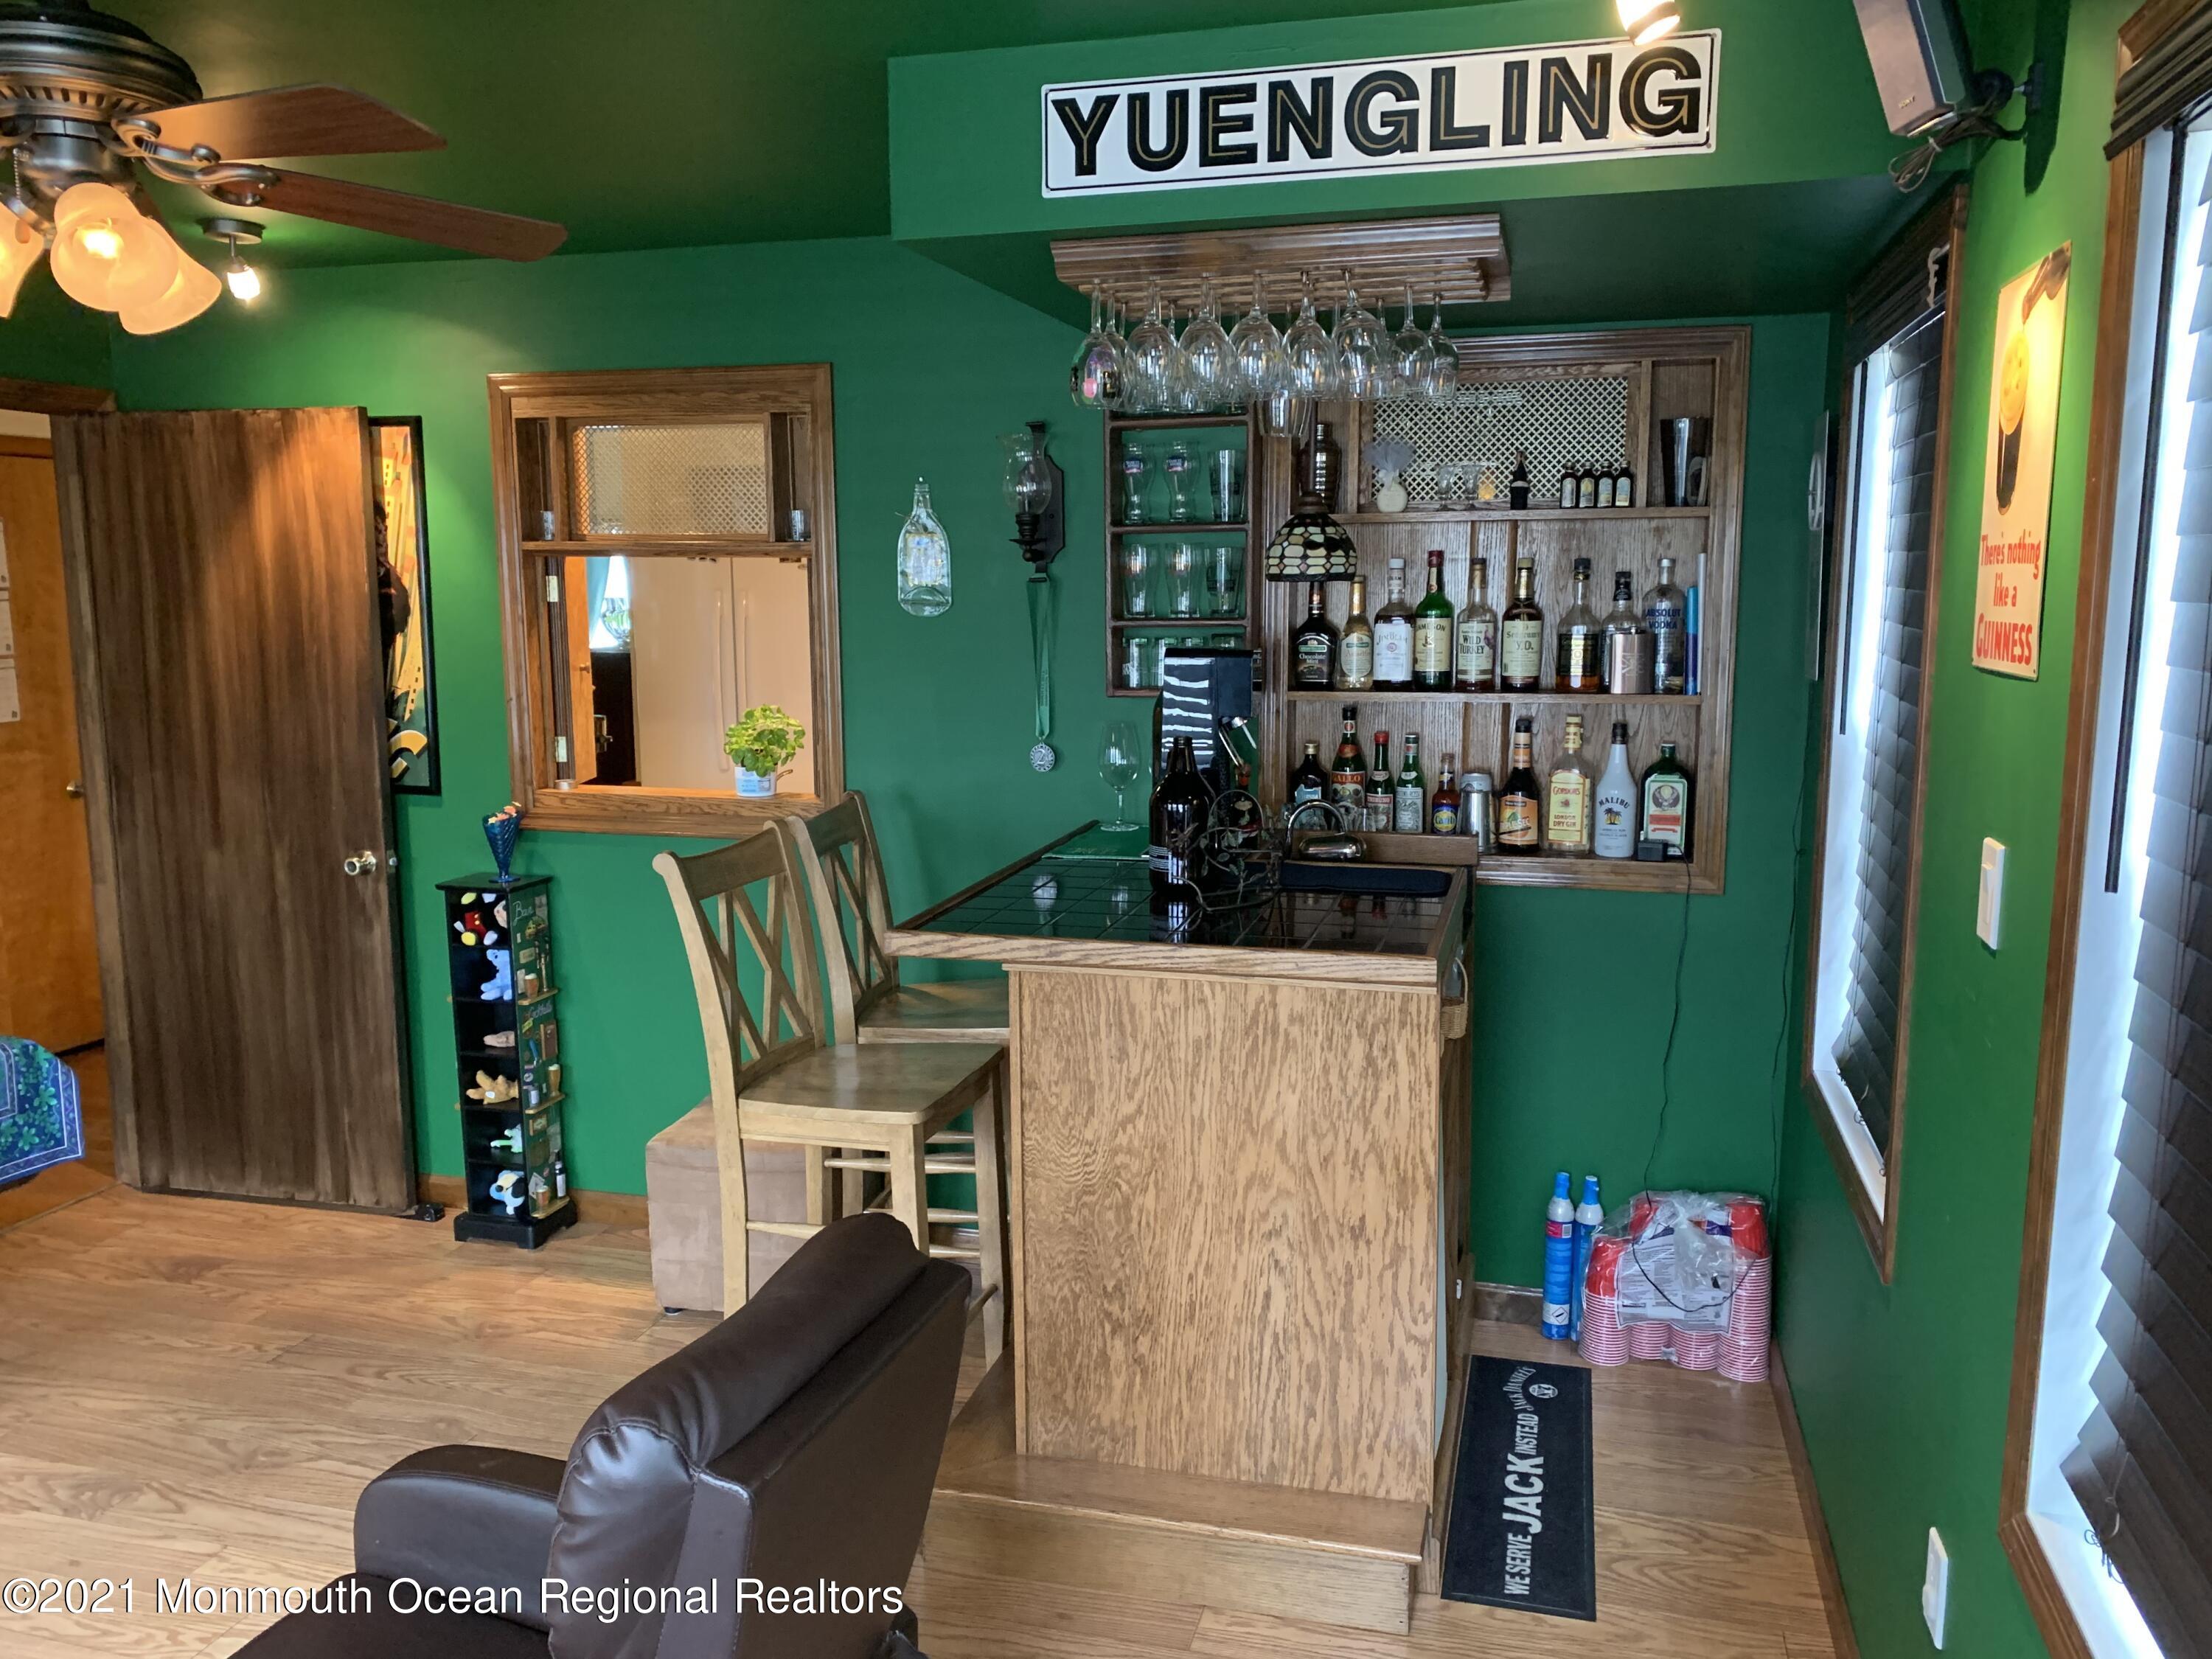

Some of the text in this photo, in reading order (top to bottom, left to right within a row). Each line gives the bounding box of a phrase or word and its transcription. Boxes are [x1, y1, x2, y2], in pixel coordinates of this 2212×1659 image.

[1051, 46, 1701, 176] YUENGLING
[1981, 529, 2041, 580] There's nothing
[1993, 572, 2017, 607] like a
[1646, 608, 1681, 617] ABSOLUT
[1648, 621, 1677, 629] VODKA
[1459, 644, 1485, 654] TURKEY
[1462, 635, 1481, 644] WILD
[1976, 613, 2033, 666] GUINNESS
[1598, 796, 1630, 809] MALIBU
[1502, 1413, 1545, 1595] WE SERVE JACK INSTEAD
